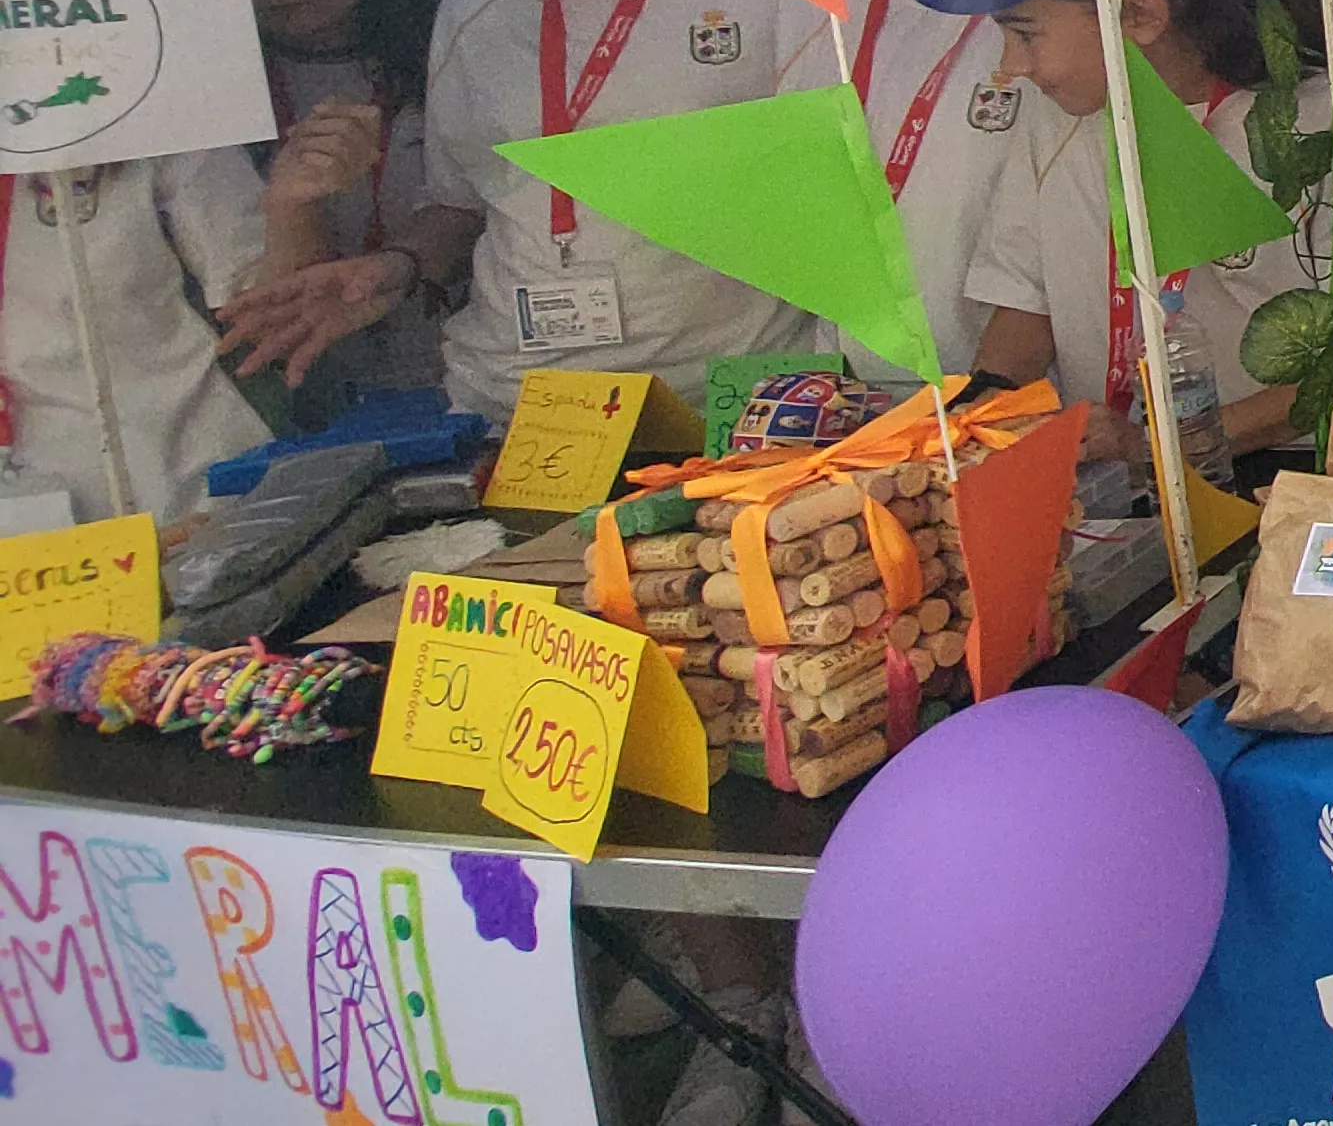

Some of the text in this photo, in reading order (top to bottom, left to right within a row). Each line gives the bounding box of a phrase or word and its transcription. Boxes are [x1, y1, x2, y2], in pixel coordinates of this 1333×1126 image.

[506, 440, 575, 482] 3€
[521, 609, 630, 702] POSAVASOS
[425, 658, 470, 712] 50
[450, 720, 483, 752] cts
[506, 707, 599, 802] 2,50€
